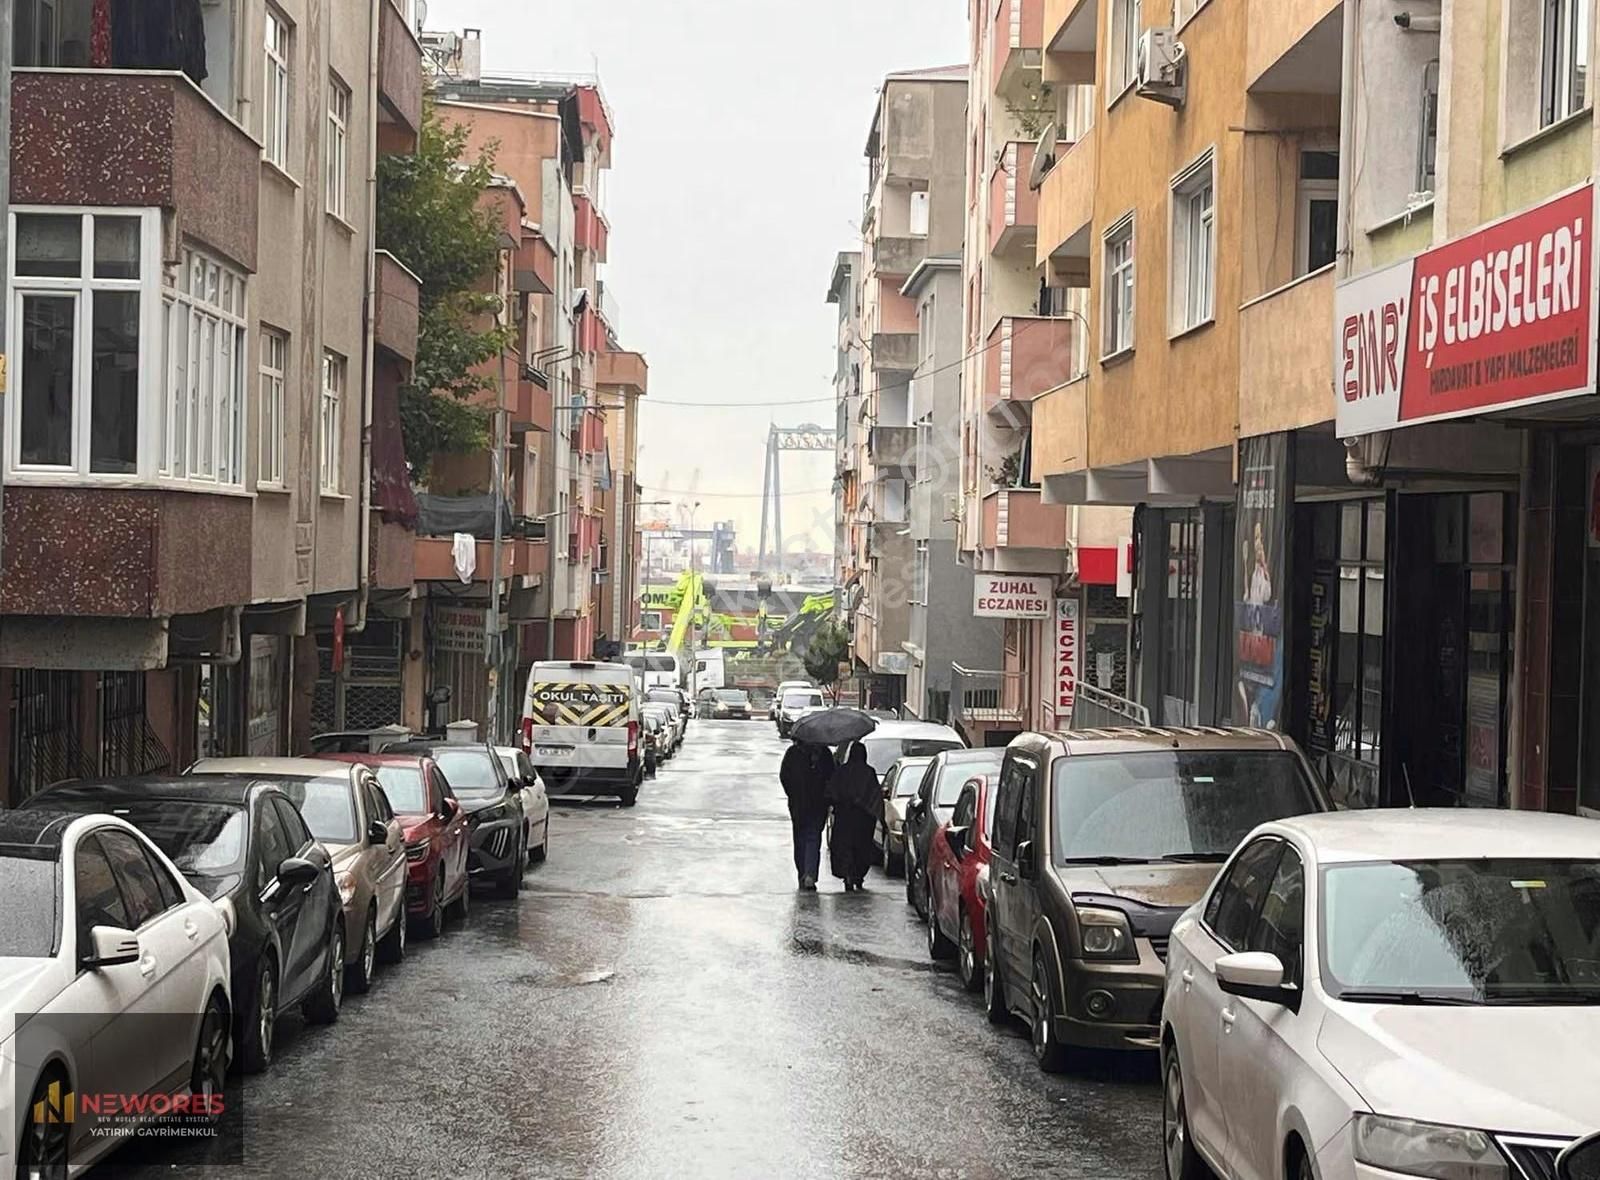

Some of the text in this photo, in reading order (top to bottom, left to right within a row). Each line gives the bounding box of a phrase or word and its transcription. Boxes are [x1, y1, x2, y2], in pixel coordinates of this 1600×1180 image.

[1418, 218, 1582, 369] İŞ ELBİSELERİ
[1430, 362, 1474, 396] HIRDAVAT
[1484, 351, 1506, 384] YAPI
[1508, 328, 1580, 379] MALZEMELERİ
[989, 581, 1038, 595] ZUHAL
[539, 691, 578, 702] OKUL
[1059, 619, 1075, 707] ECZANE
